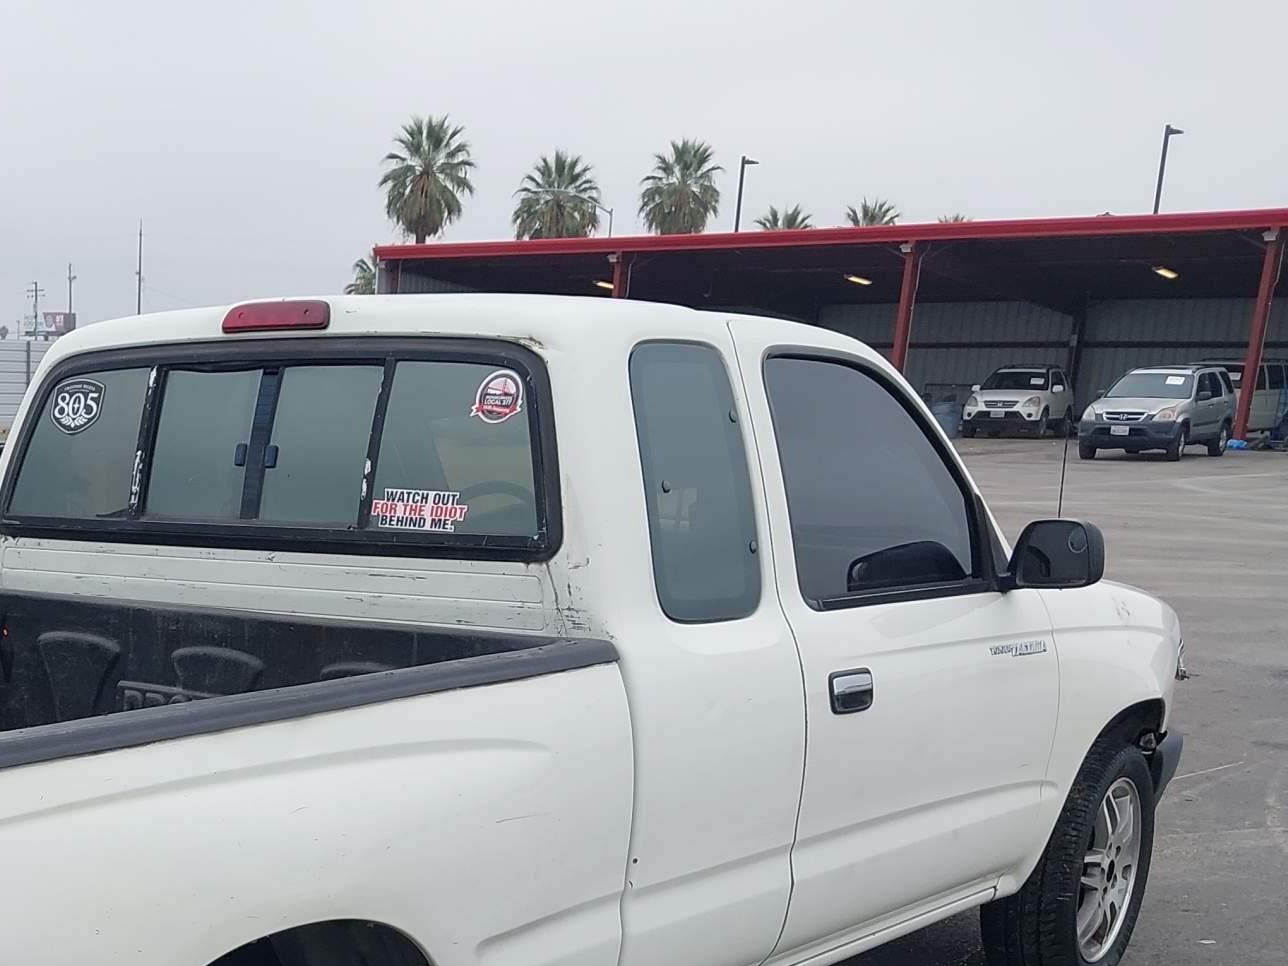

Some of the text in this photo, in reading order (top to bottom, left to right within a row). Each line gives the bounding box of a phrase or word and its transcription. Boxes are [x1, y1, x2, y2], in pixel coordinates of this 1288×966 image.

[54, 392, 99, 419] 805
[386, 490, 458, 506] WATCH OUT
[372, 501, 466, 519] FOR THE IDIOT
[380, 514, 453, 531] BEHIND ME.
